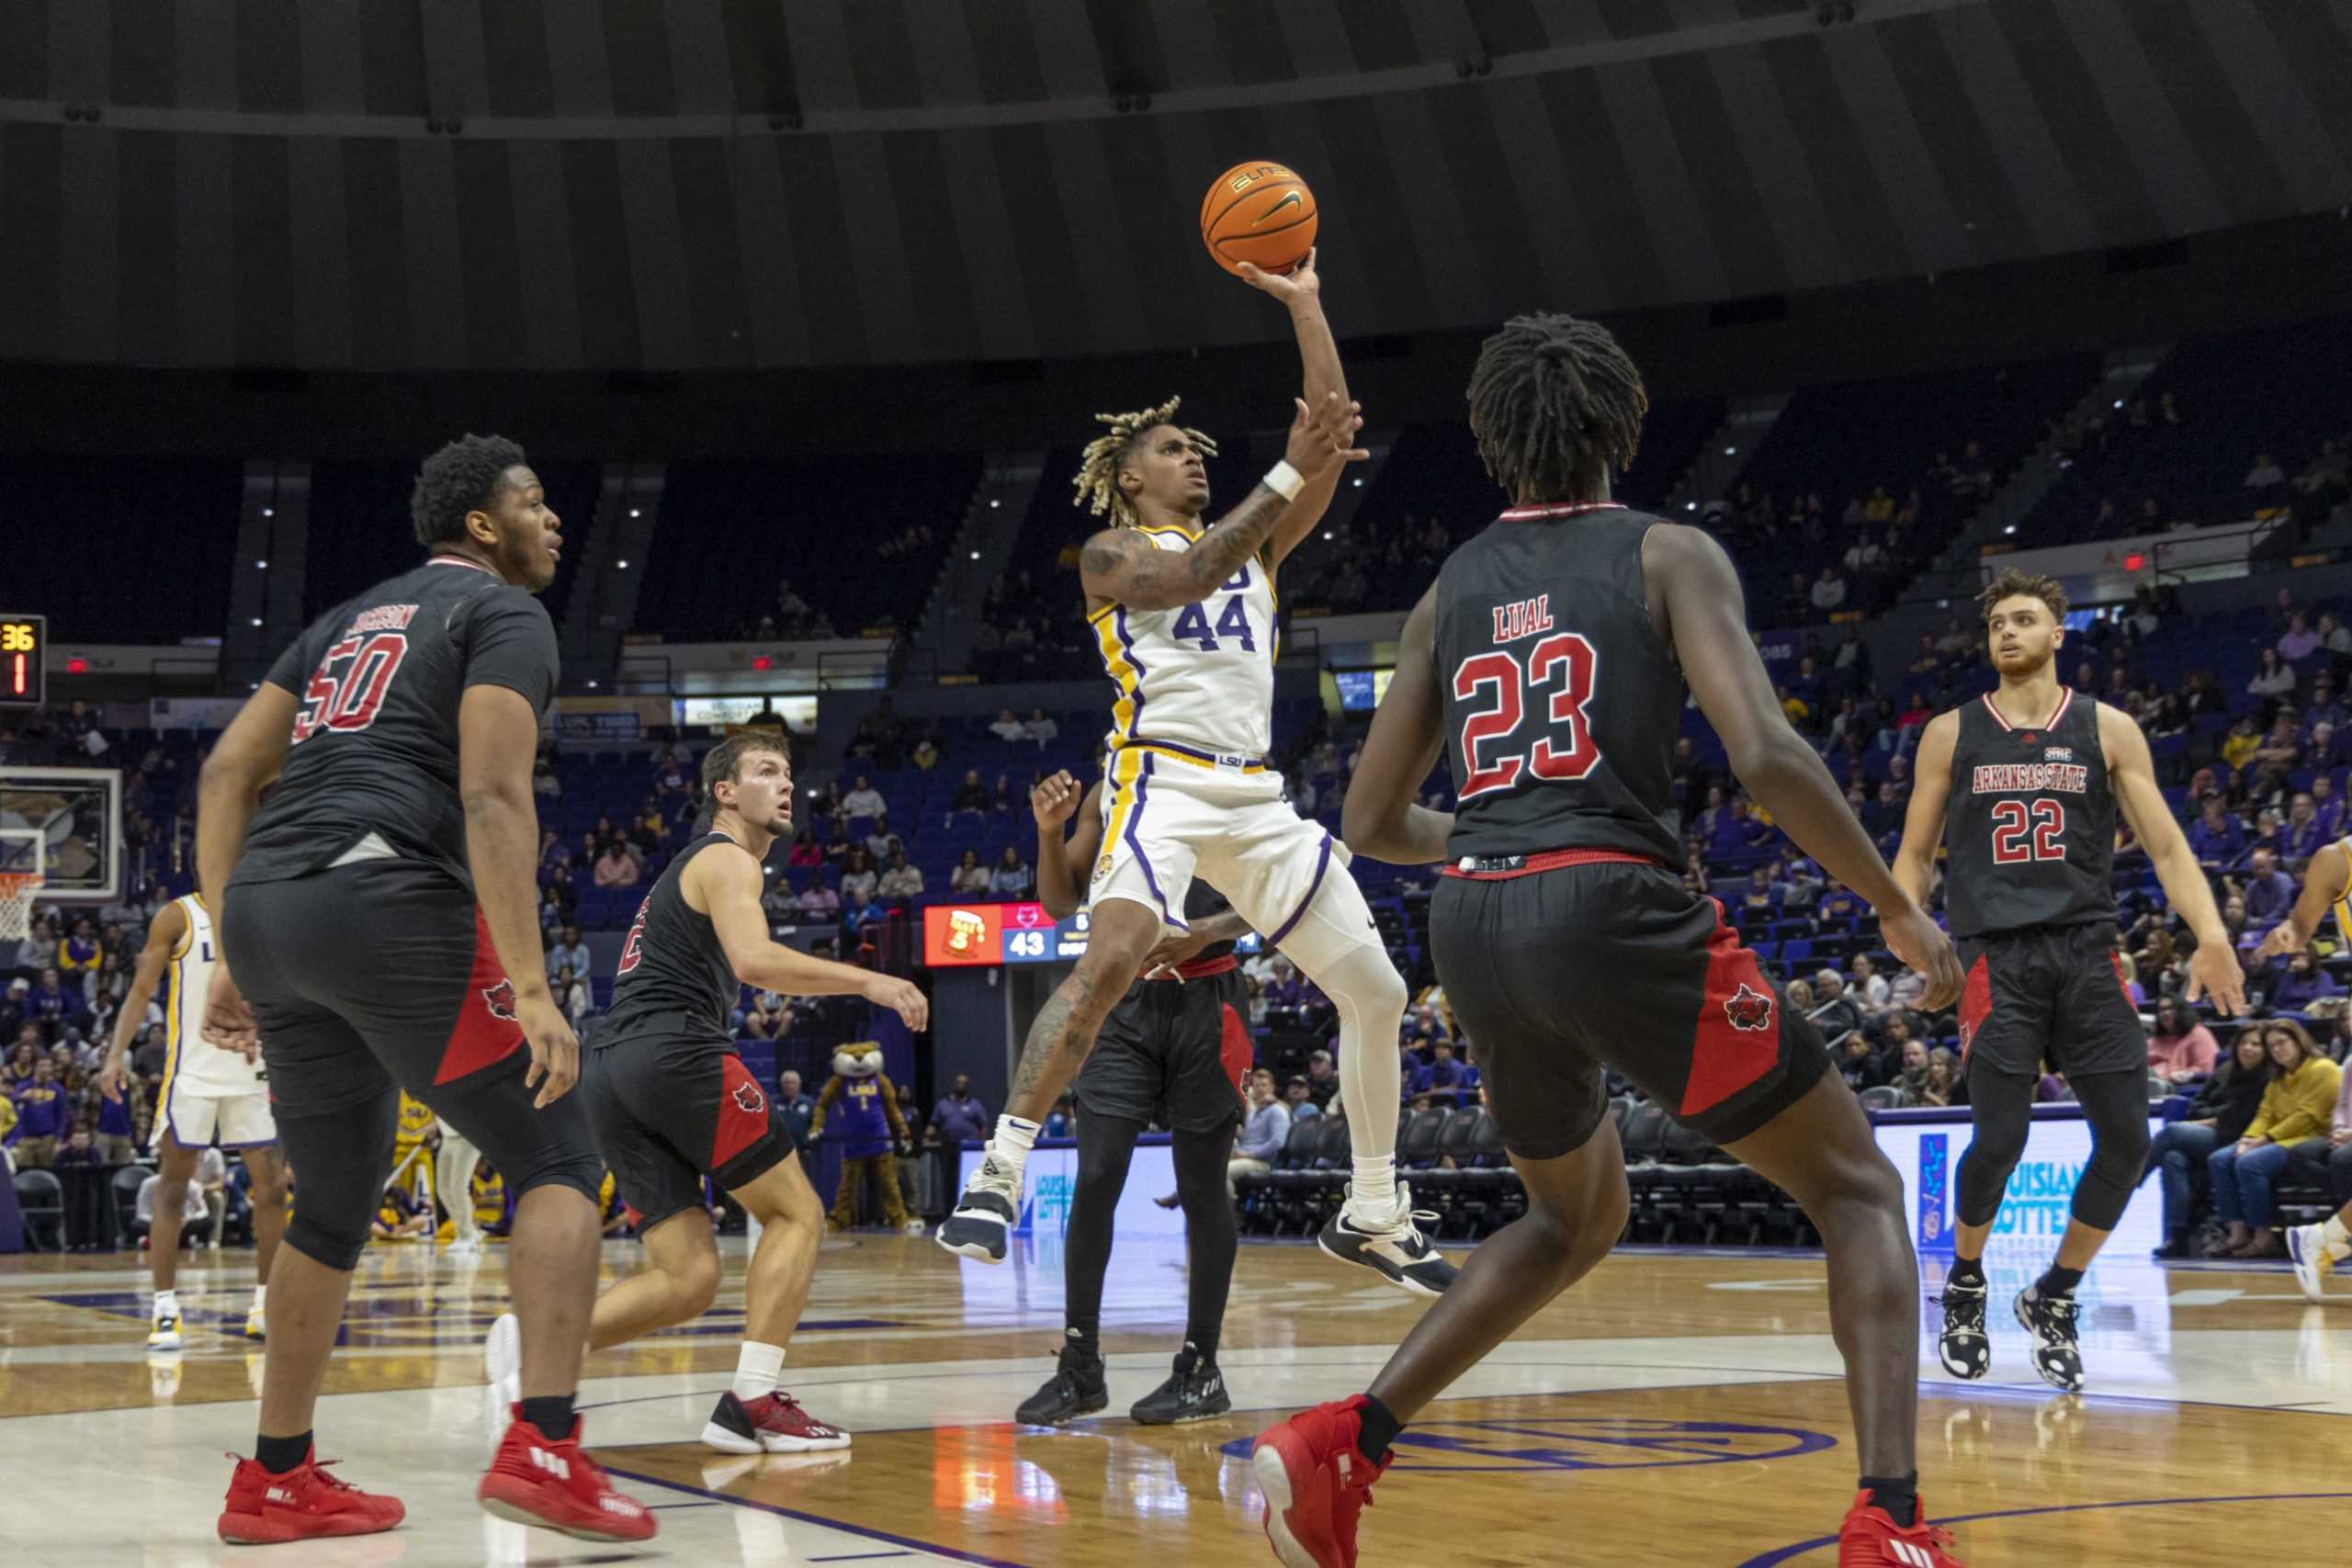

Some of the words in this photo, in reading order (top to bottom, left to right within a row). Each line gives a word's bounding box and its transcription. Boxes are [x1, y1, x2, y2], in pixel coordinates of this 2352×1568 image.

[1229, 165, 1290, 193] ELITE
[2, 625, 35, 651] 36
[1172, 594, 1257, 652] 44
[1493, 593, 1554, 644] LUAL
[15, 653, 26, 694] 1
[291, 633, 409, 746] 50
[1453, 632, 1601, 802] 23
[1219, 755, 1242, 767] LSU
[1973, 764, 2044, 794] ARKANSAS
[2043, 763, 2087, 794] STATE
[1992, 798, 2066, 864] 22
[1010, 931, 1045, 956] 43
